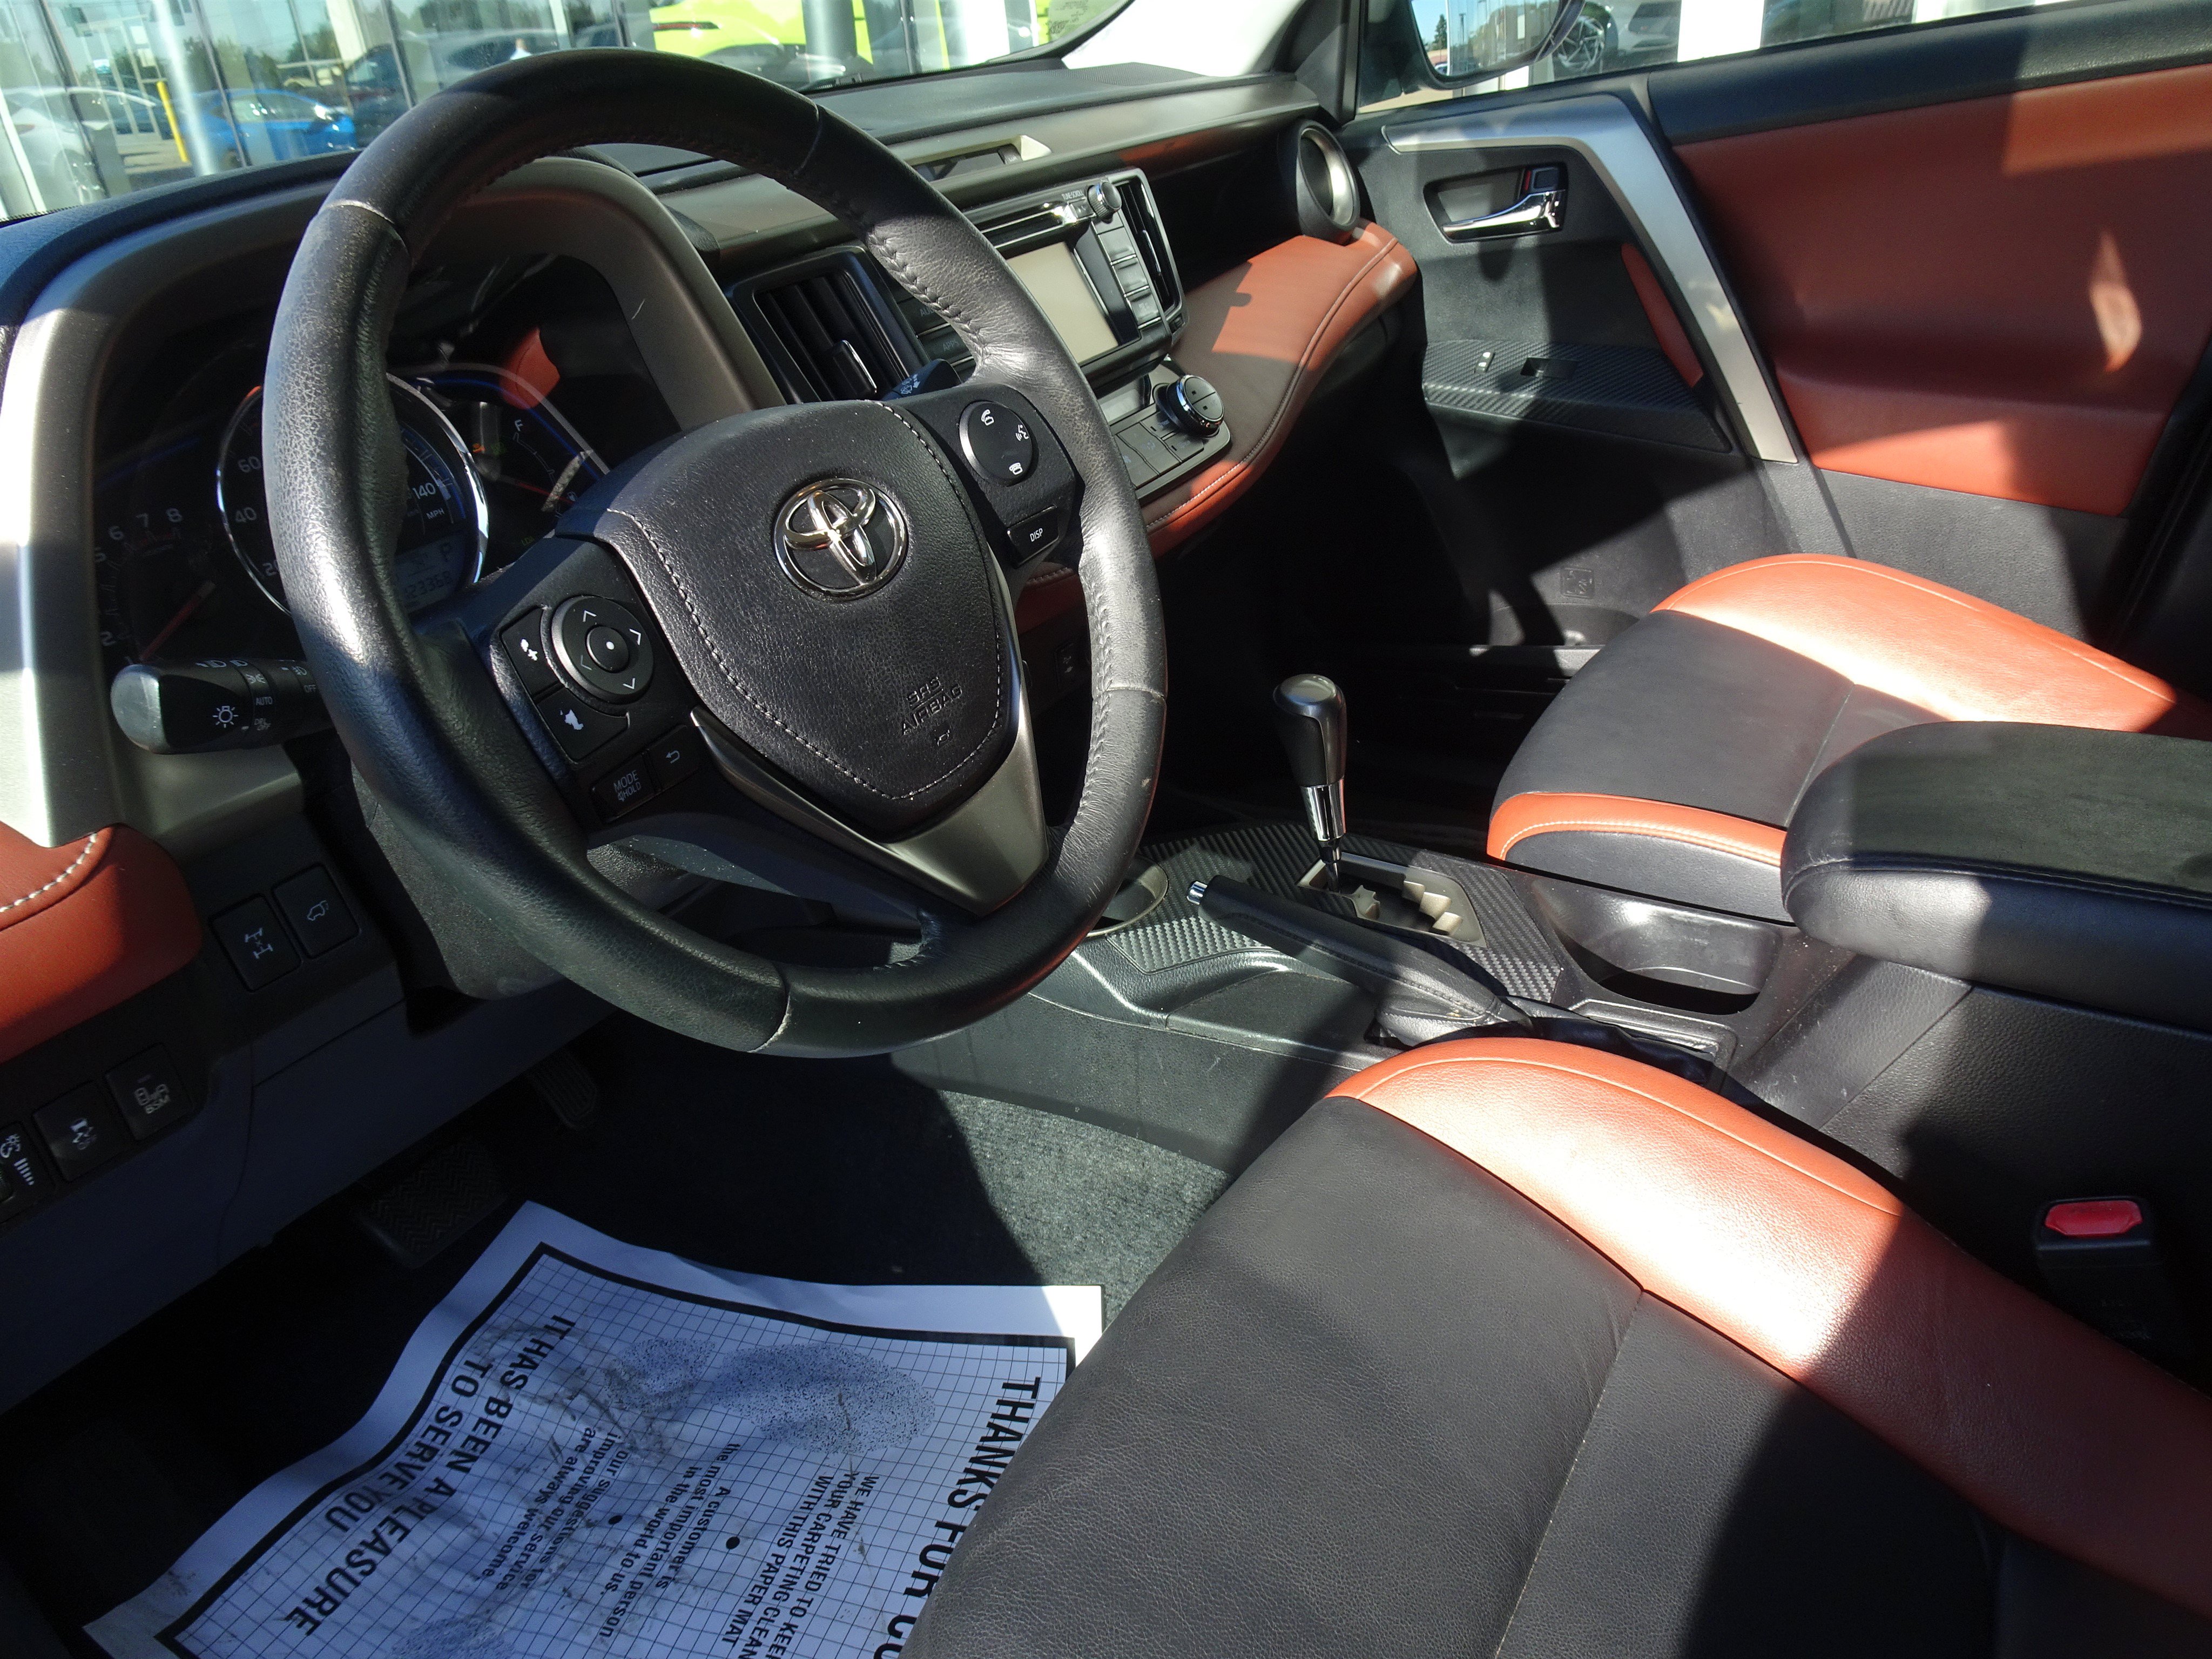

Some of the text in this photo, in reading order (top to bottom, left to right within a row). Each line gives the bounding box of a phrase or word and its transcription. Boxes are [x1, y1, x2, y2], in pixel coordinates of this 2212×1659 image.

[514, 419, 523, 432] F
[238, 456, 261, 473] 60
[412, 482, 436, 499] 140
[165, 507, 183, 523] 8
[235, 507, 257, 523] 40
[426, 509, 444, 520] MPH
[108, 525, 125, 541] 6
[1029, 528, 1043, 542] DISP
[255, 696, 273, 706] AUTO
[906, 676, 941, 707] SRS
[902, 684, 963, 736] AIRBAG
[613, 770, 639, 792] MODE
[325, 1359, 490, 1533] TO SERVE YOU
[575, 1427, 596, 1453] are
[947, 1377, 1041, 1511] THANKS
[286, 1314, 576, 1636] IT HAS BEEN A PLEASURE
[535, 1456, 577, 1504] always
[861, 1475, 880, 1498] WE
[496, 1432, 618, 1590] improving our service
[541, 1479, 610, 1564] suggestions
[836, 1501, 864, 1540] HAVE
[599, 1443, 740, 1637] the most important person
[600, 1466, 702, 1595] in the world to us.
[655, 1486, 731, 1589] A customer is
[721, 1475, 834, 1647] WITH THIS PAPER MAT
[738, 1471, 860, 1659] YOUR CARPETING CLEAN
[804, 1542, 841, 1593] TRIED
[788, 1596, 813, 1618] TO
